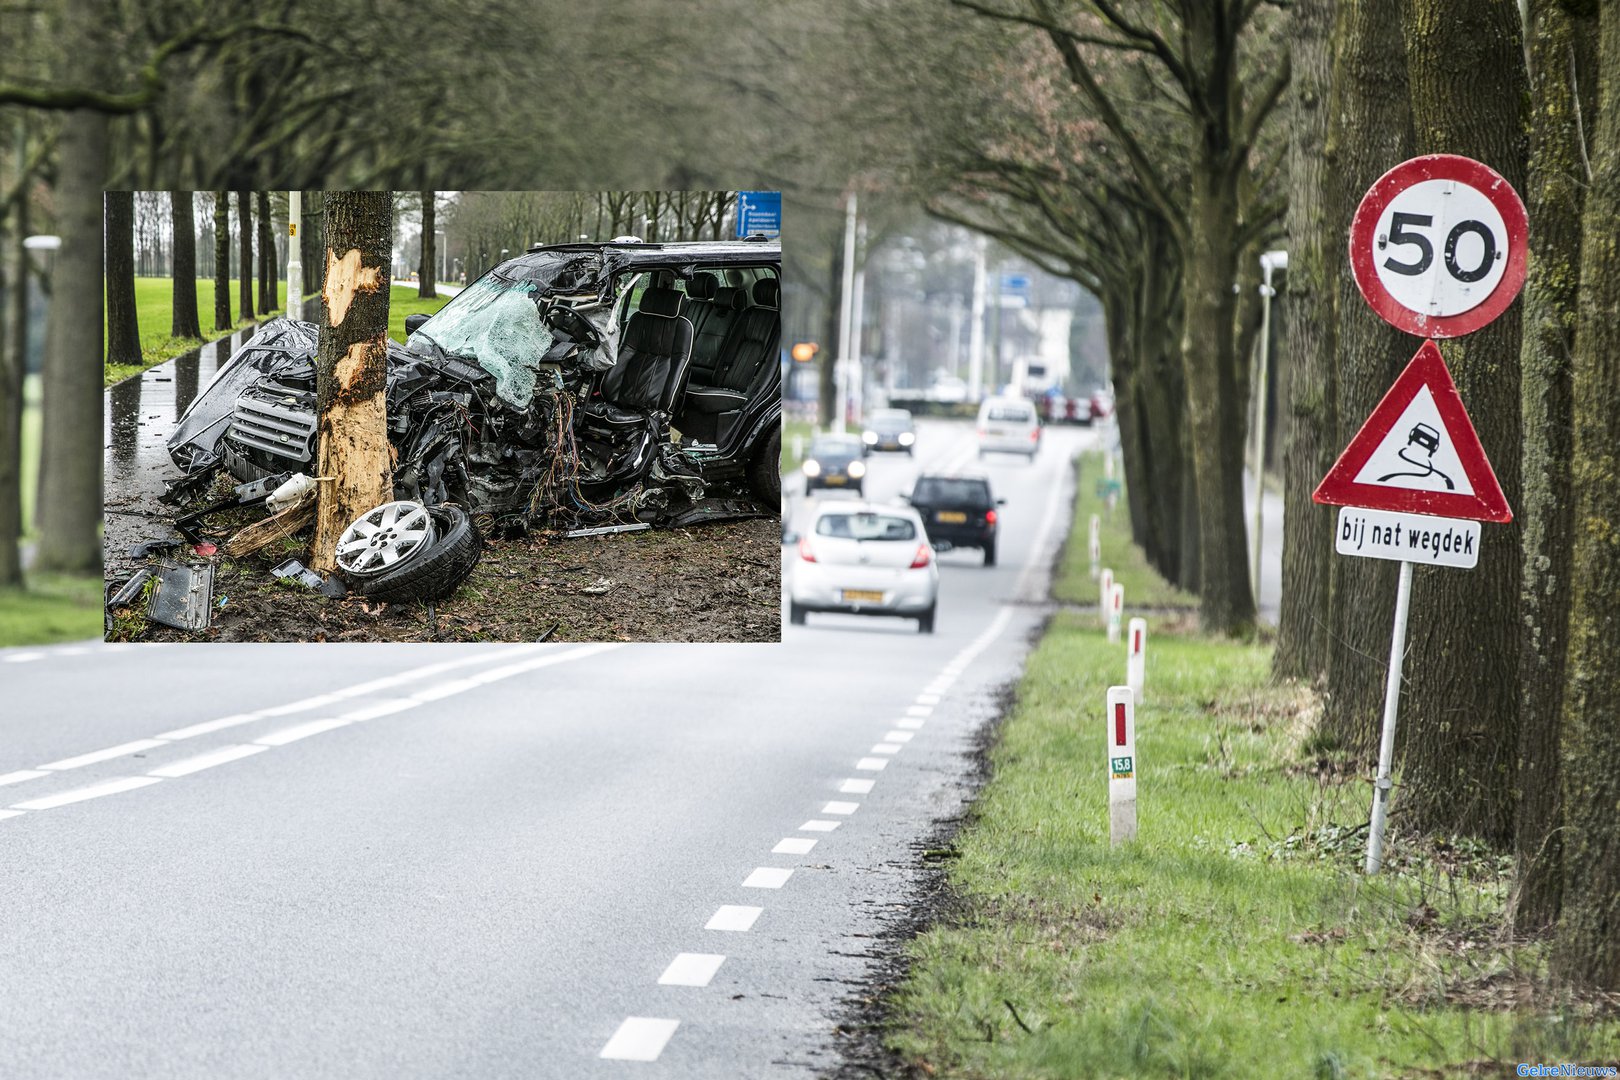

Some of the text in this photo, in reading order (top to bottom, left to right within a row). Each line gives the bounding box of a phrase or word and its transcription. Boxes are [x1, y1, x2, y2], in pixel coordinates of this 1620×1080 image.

[1383, 211, 1496, 283] 50
[1342, 516, 1474, 559] bij nat wegdek
[1113, 758, 1131, 771] 15,8
